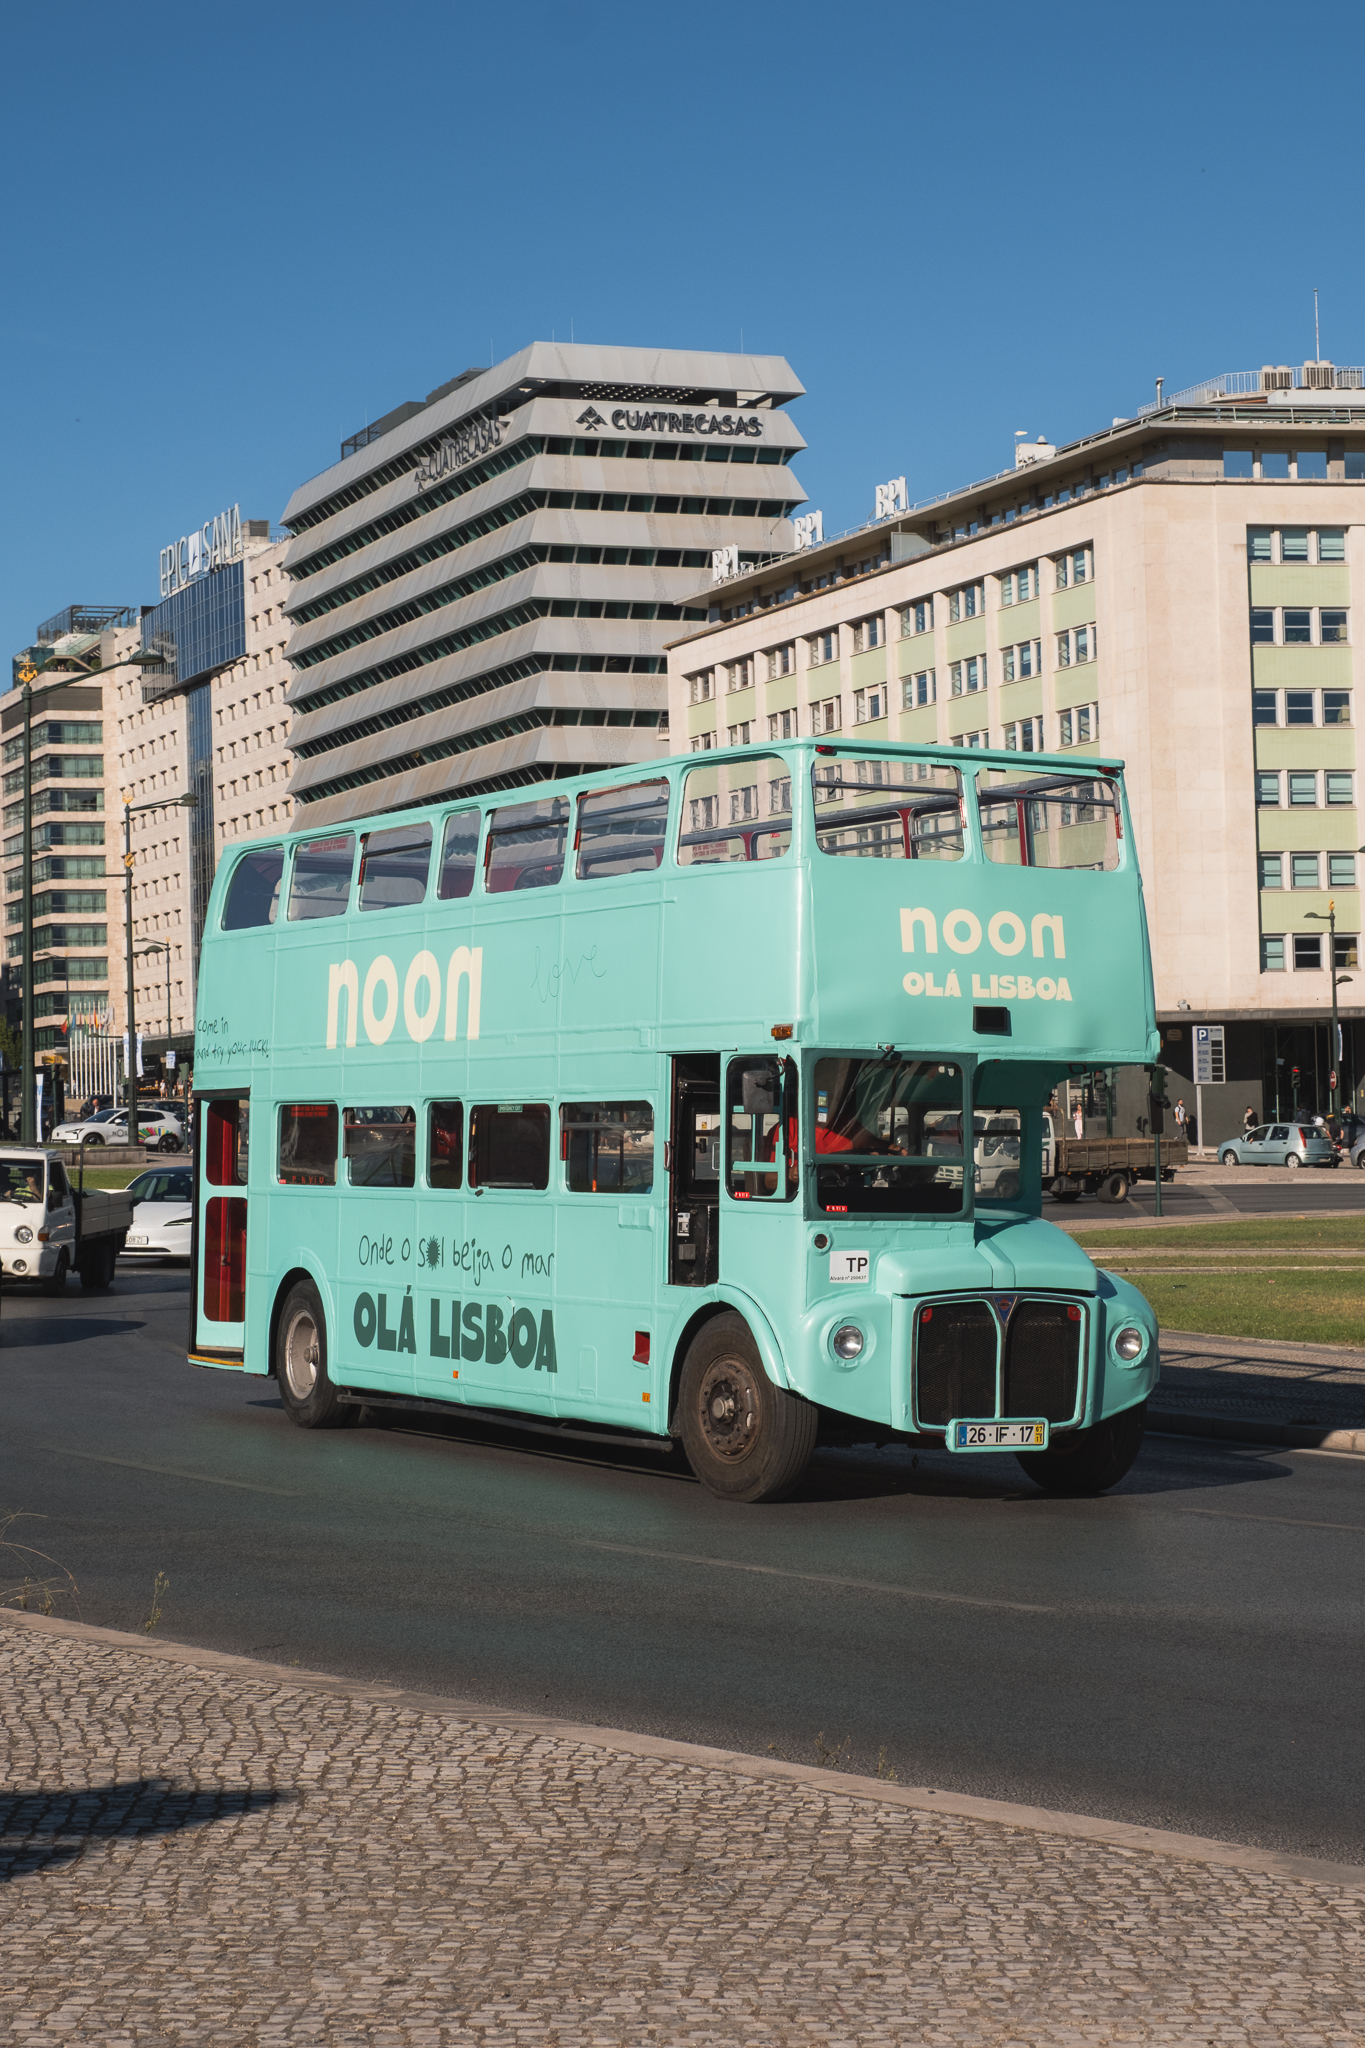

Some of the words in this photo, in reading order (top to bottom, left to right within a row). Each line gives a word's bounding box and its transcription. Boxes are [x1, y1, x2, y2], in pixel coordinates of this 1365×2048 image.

[611, 409, 764, 437] CUATRECASAS
[428, 416, 502, 480] CUATRECASAS
[875, 475, 907, 519] BPI
[160, 536, 188, 597] EPIC
[203, 503, 244, 572] SANA
[794, 509, 823, 550] BPI
[712, 543, 739, 583] BPI
[899, 907, 1066, 959] noon
[530, 944, 607, 1003] love
[902, 968, 962, 998] OLÁ
[972, 973, 1073, 1002] LISBOA
[326, 945, 483, 1050] noon
[197, 1019, 218, 1036] come
[221, 1016, 229, 1035] in
[1198, 1029, 1207, 1041] P
[195, 1043, 210, 1060] and
[212, 1043, 225, 1064] try
[227, 1041, 247, 1064] your
[358, 1233, 394, 1266] Onde
[453, 1238, 494, 1286] beija
[522, 1252, 554, 1279] mar
[845, 1257, 868, 1273] TP
[353, 1285, 417, 1354] OLÁ
[430, 1298, 558, 1374] LISBOA
